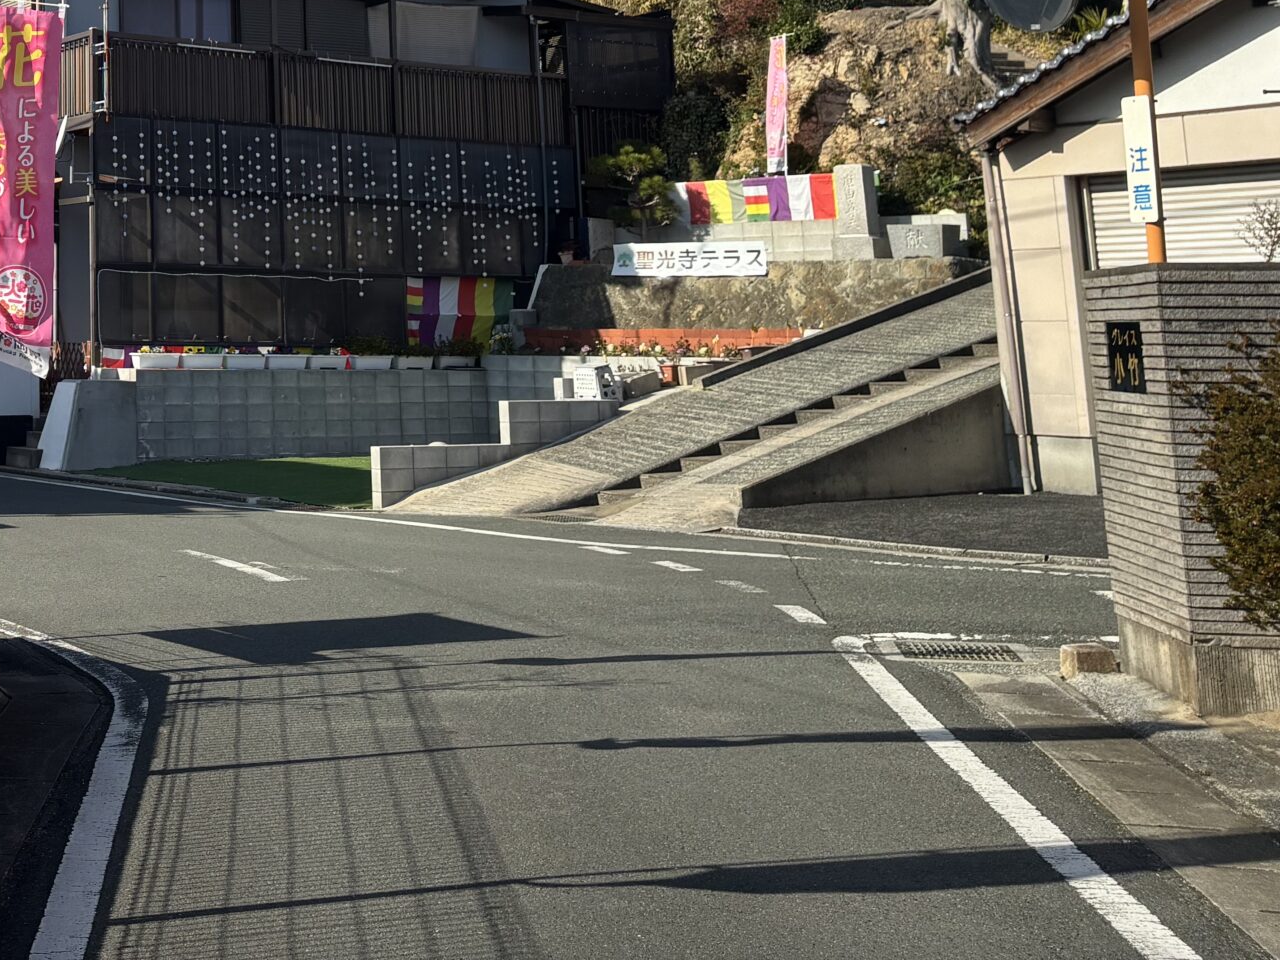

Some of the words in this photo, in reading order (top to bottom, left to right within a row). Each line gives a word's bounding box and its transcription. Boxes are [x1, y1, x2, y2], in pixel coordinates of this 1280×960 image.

[1129, 146, 1153, 211] 注意
[634, 248, 764, 271] 聖光寺テラス
[1111, 328, 1137, 346] グレイス
[1114, 352, 1139, 385] 小竹
